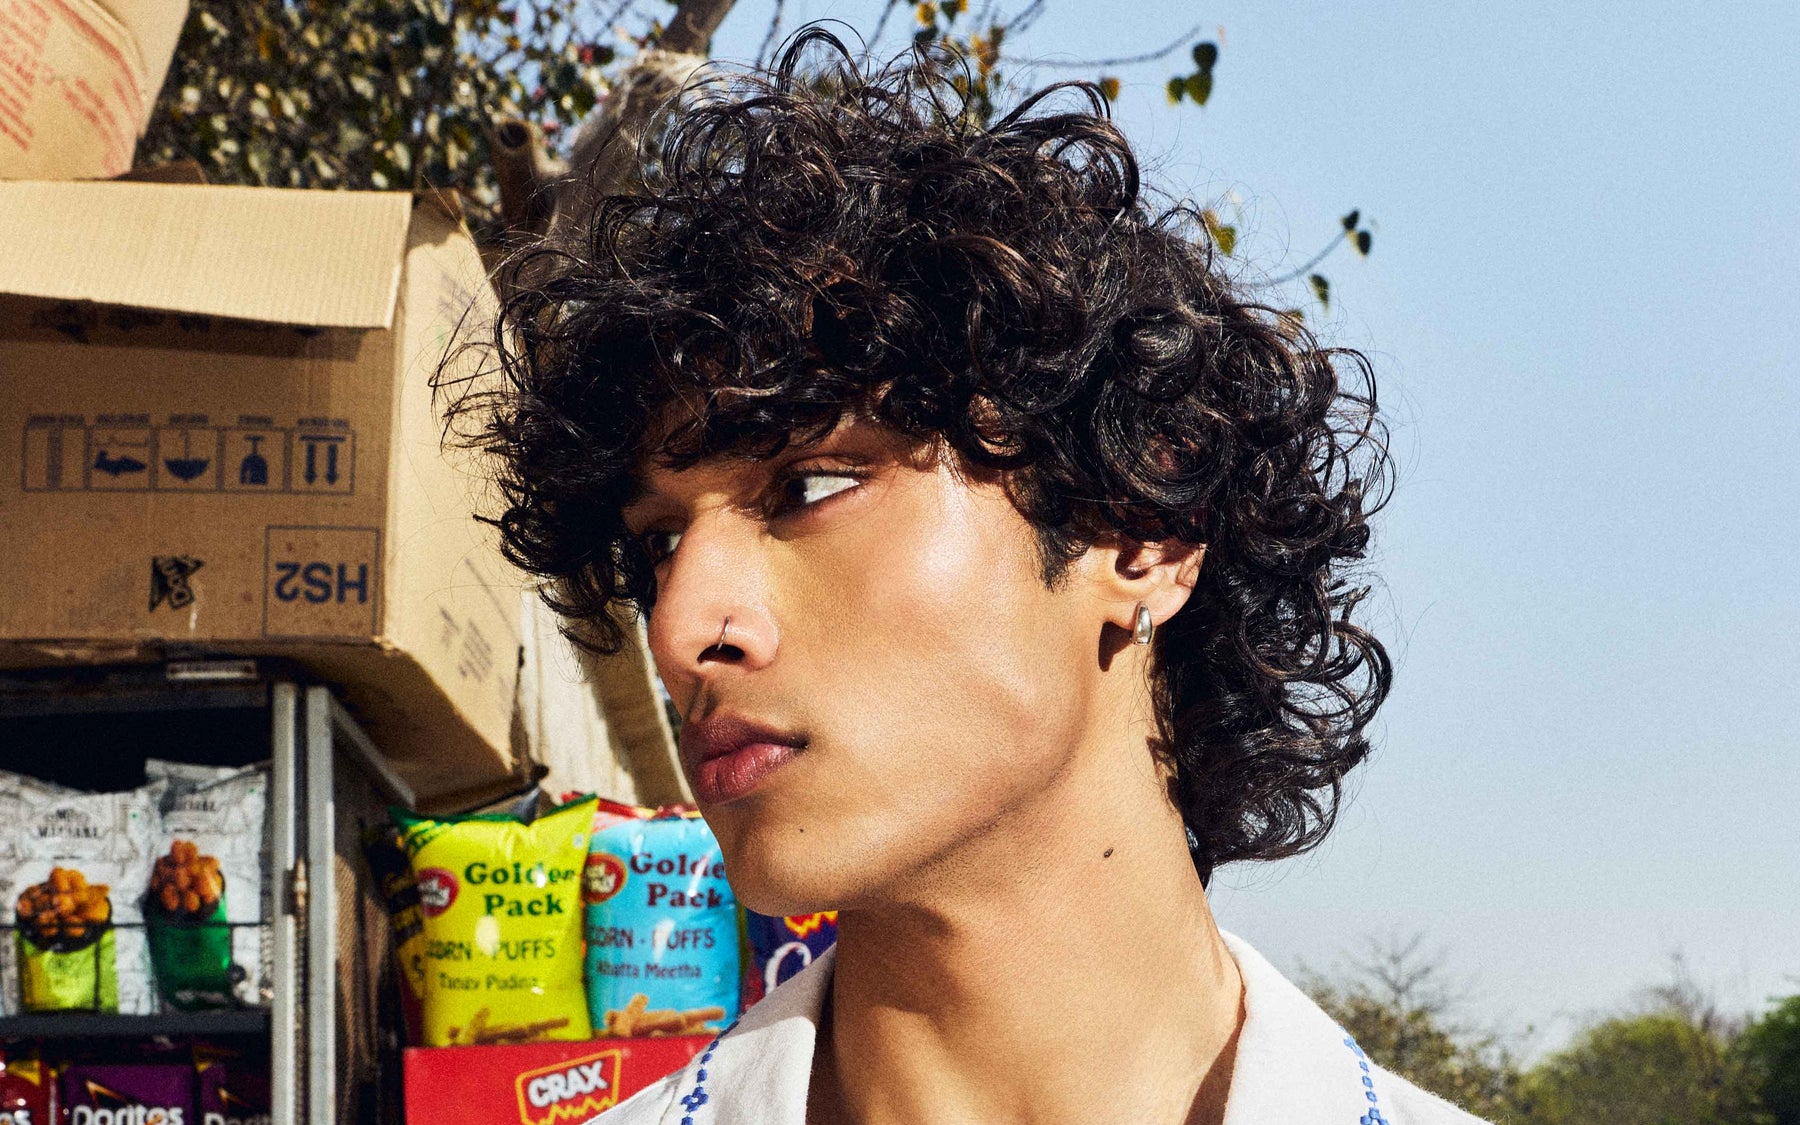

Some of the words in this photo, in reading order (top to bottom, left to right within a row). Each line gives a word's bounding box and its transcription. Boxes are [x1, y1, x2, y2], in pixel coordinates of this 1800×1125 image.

[275, 562, 367, 604] HS2
[464, 861, 576, 886] Golden
[485, 893, 563, 917] Pack
[648, 882, 722, 909] Pack
[527, 1059, 610, 1108] CRAX
